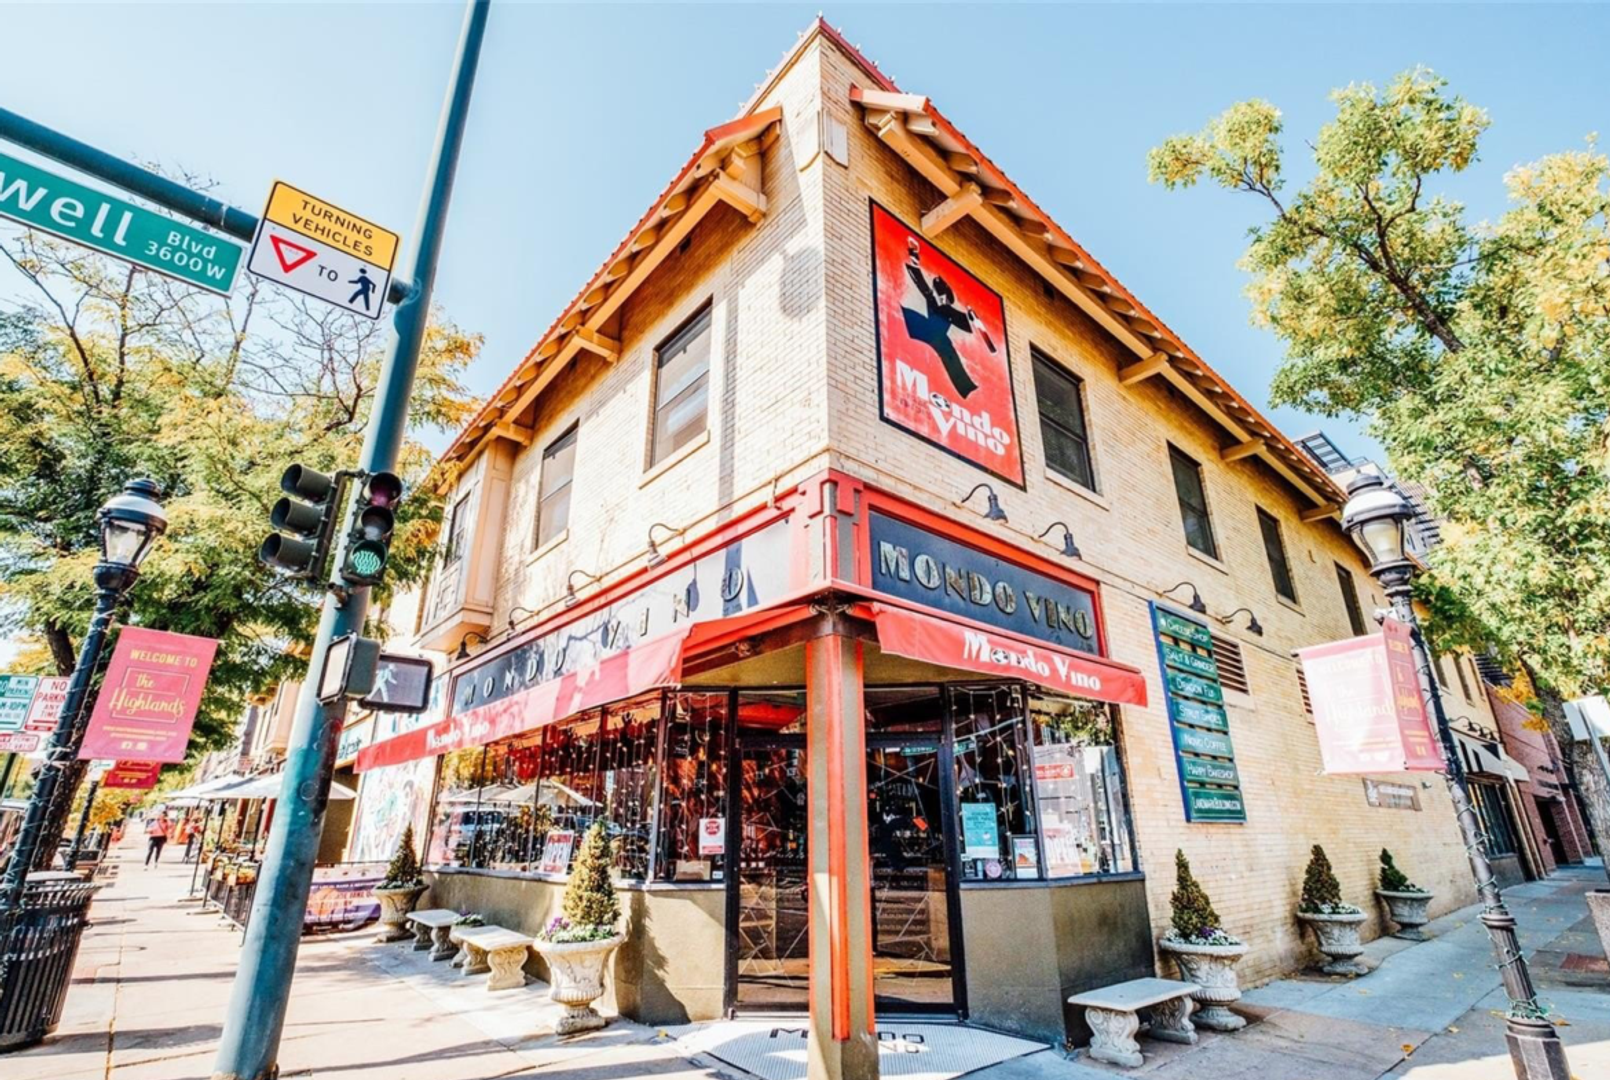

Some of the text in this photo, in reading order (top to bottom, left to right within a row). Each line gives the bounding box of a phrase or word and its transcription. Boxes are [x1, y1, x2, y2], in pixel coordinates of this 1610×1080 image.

[292, 212, 373, 257] VEHICLES
[301, 199, 373, 240] TURNING
[166, 230, 217, 260] Blvd
[318, 264, 339, 282] TO
[895, 357, 1011, 446] Mondo
[926, 403, 1007, 456] Vino
[877, 540, 1094, 640] MONDO VINO
[130, 649, 198, 668] WELCOME TO
[463, 646, 567, 707] MONDO
[963, 630, 1101, 691] Mondo Vino
[37, 692, 67, 701] PARKIN
[50, 681, 68, 691] NO
[135, 672, 154, 688] the
[109, 686, 185, 718] Highlands
